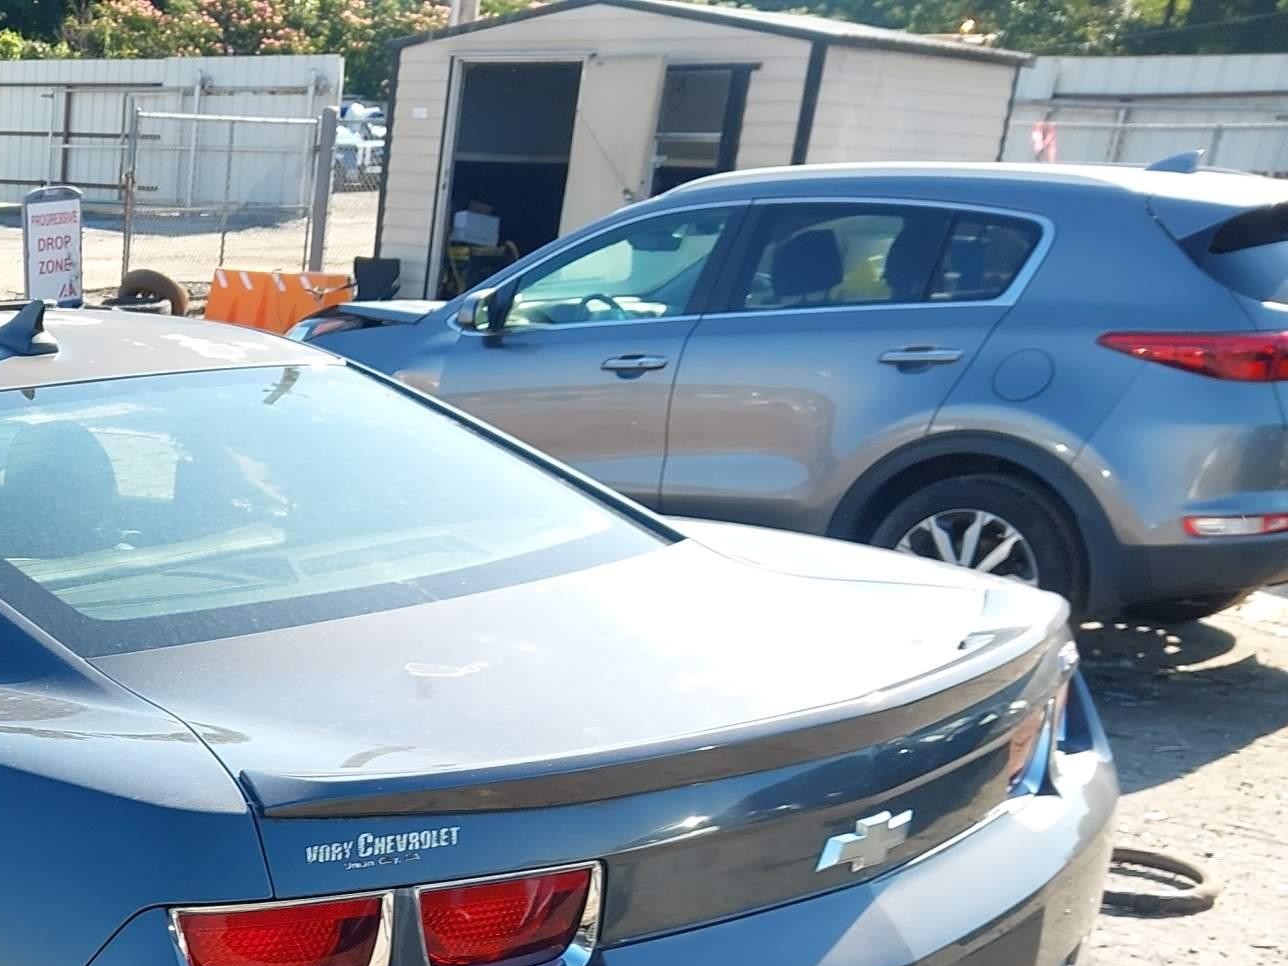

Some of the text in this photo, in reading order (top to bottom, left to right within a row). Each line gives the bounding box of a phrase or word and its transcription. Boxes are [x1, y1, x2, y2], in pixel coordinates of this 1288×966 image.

[37, 235, 71, 252] DROP
[38, 258, 71, 275] ZONE
[357, 826, 461, 858] CHEVROLET
